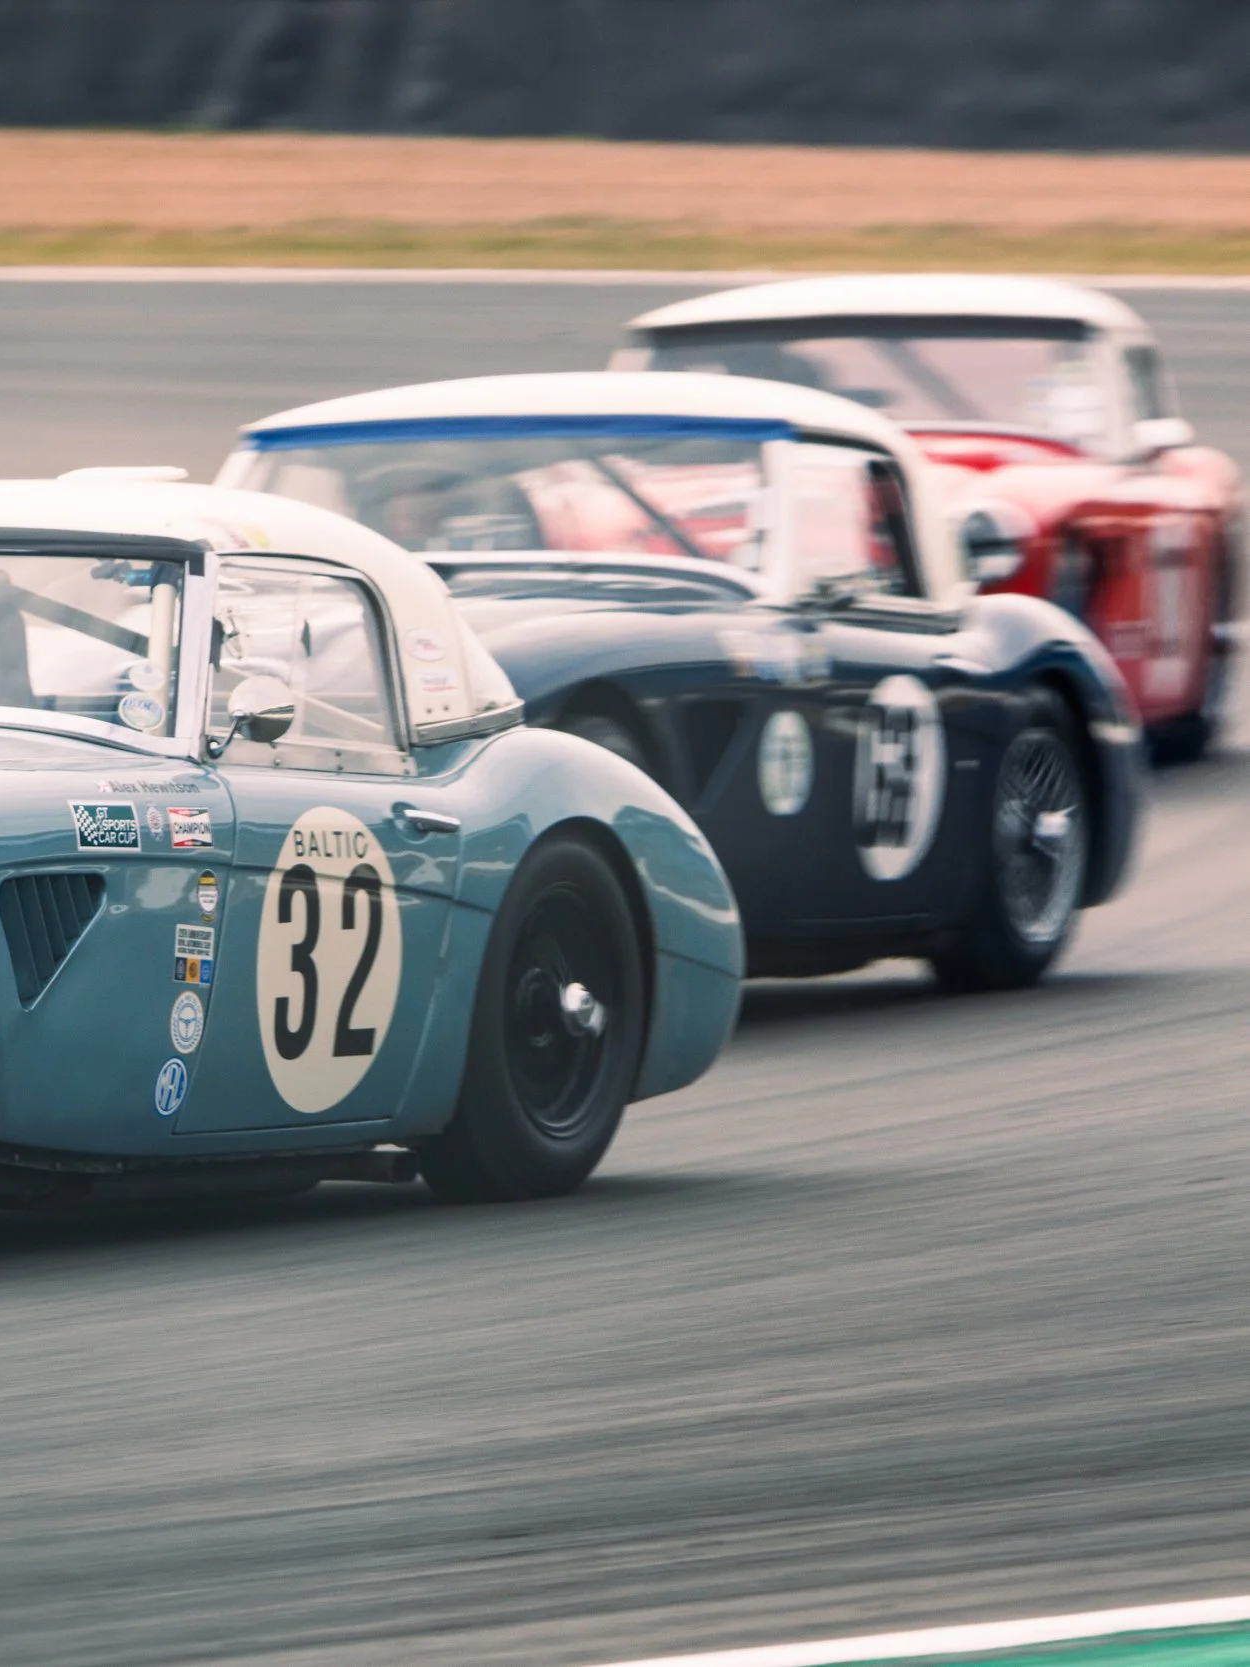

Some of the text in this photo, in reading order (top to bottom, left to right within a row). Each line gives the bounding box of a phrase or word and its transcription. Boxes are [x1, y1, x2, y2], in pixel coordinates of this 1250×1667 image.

[110, 781, 138, 793] Alex
[96, 807, 108, 819] GT
[103, 819, 136, 831] SPORTS
[174, 822, 211, 834] CHAMPION
[99, 832, 136, 844] CAR CUP
[293, 830, 368, 858] BALTIC
[274, 863, 383, 1060] 32
